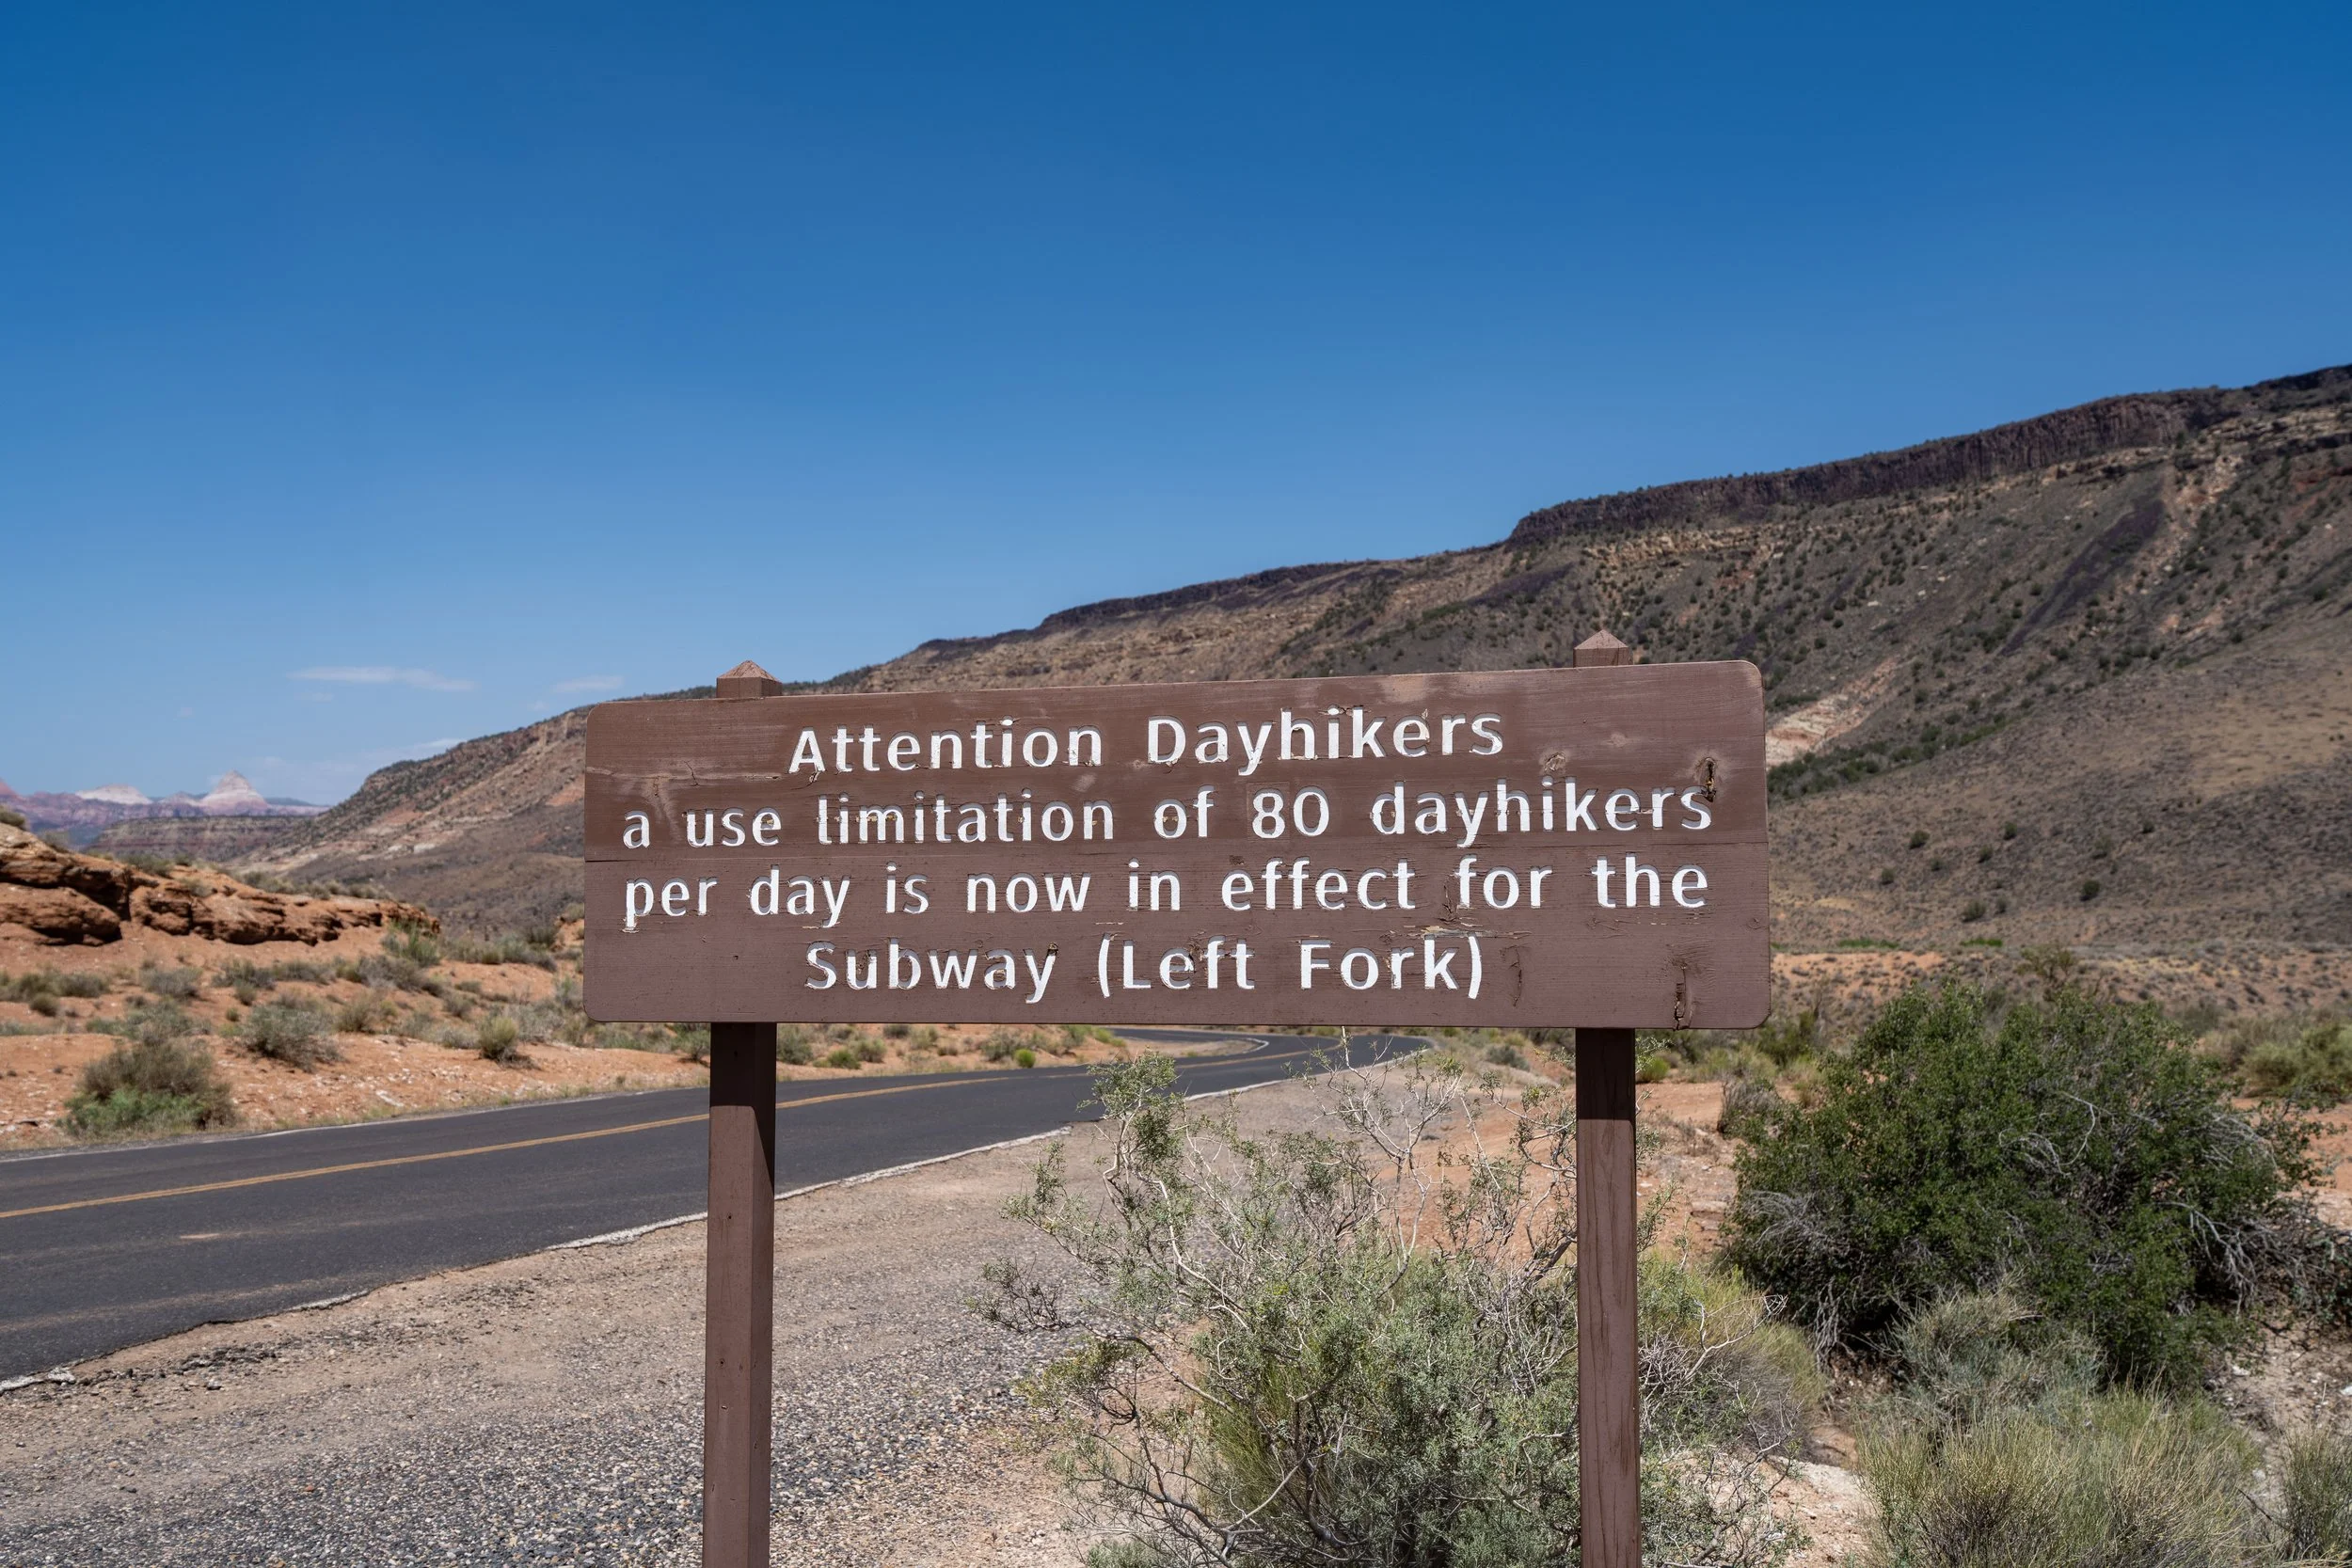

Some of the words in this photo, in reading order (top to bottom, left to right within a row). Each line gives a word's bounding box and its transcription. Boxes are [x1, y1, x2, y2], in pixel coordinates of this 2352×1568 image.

[788, 717, 1104, 773] Attention
[1147, 706, 1504, 777] Dayhikers
[623, 810, 652, 850] a
[685, 807, 783, 847] use
[818, 788, 1115, 846] limitation
[1153, 784, 1215, 840] of
[1251, 786, 1330, 839] 80
[1371, 776, 1712, 849] dayhikers
[622, 876, 718, 934] per
[750, 864, 851, 929] day
[885, 862, 930, 915] is
[966, 872, 1091, 914] now
[1128, 858, 1182, 911] in
[1221, 857, 1416, 911] effect
[1454, 854, 1554, 911] for
[1591, 853, 1709, 909] the
[804, 937, 1058, 1004] Subway
[1098, 933, 1256, 1000] (Left
[1298, 934, 1484, 1000] Fork)
